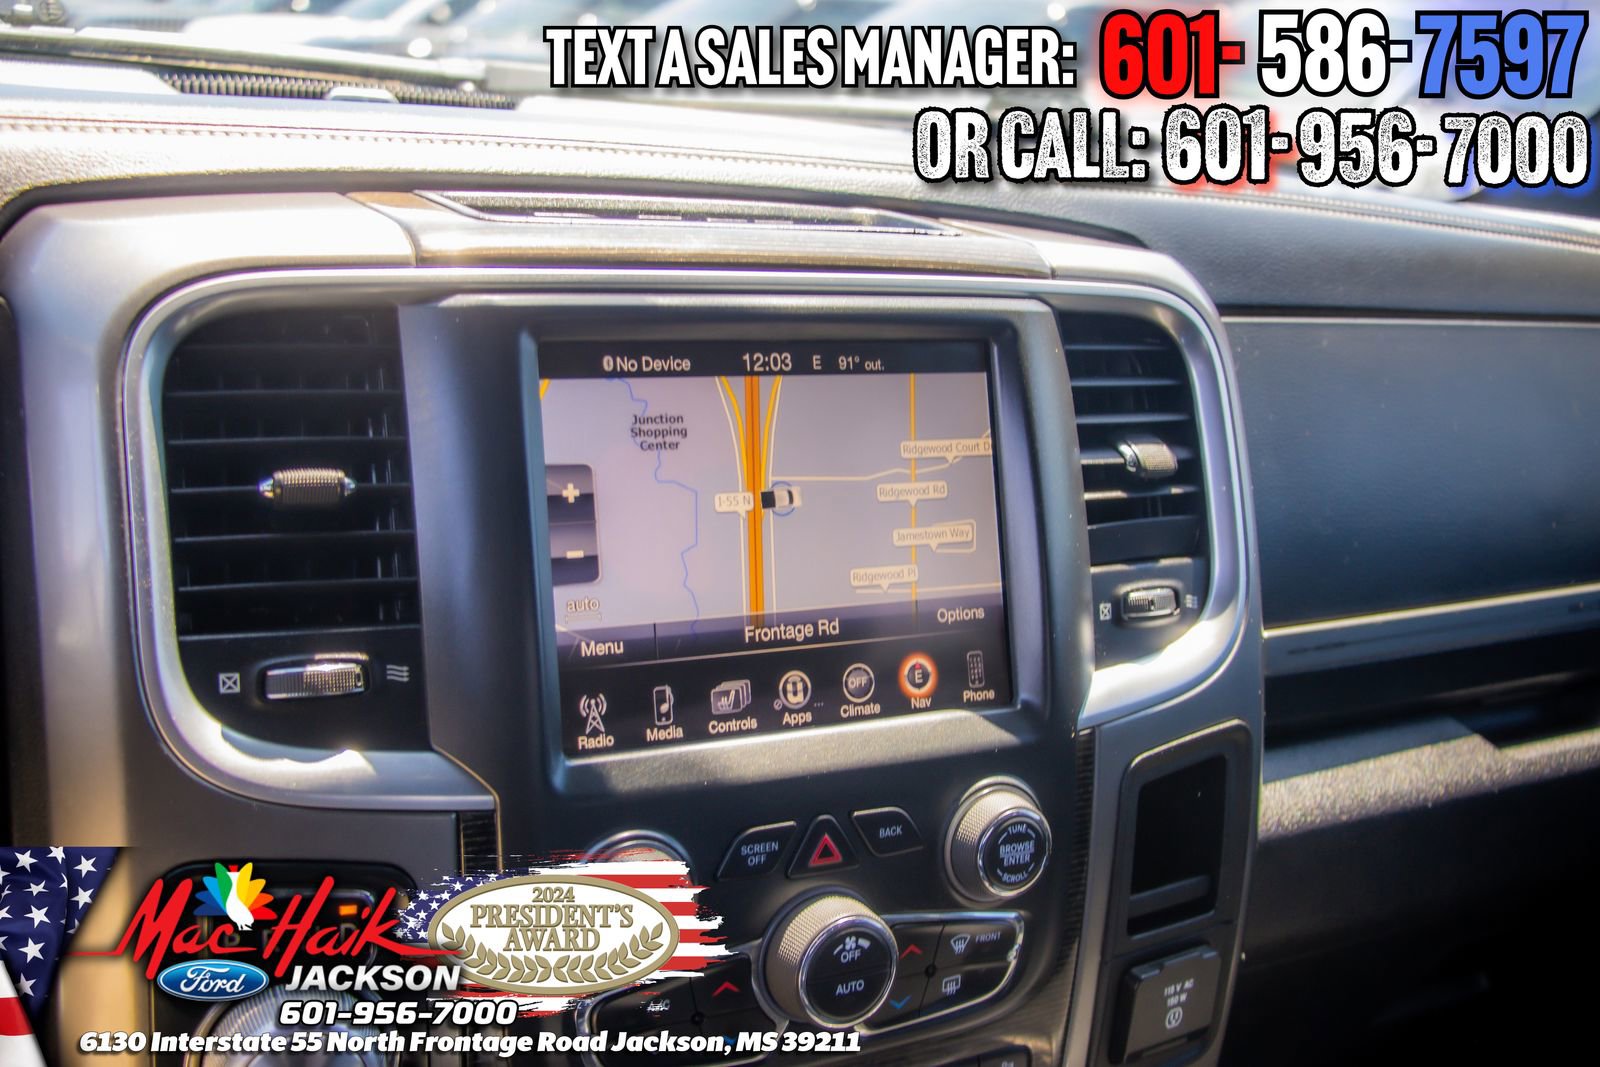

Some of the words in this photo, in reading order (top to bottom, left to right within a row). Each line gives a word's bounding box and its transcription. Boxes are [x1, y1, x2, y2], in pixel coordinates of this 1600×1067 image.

[616, 356, 638, 372] No
[641, 355, 691, 372] Device
[742, 352, 792, 372] 12:03
[812, 355, 822, 370] E
[864, 359, 885, 371] out.
[632, 413, 684, 425] Junction
[630, 427, 688, 440] Shopping
[640, 440, 680, 452] Center
[902, 442, 953, 456] Ridgewood
[955, 441, 980, 452] Court
[878, 485, 930, 499] Ridgewood
[932, 485, 946, 495] Rd
[896, 529, 948, 542] Jamestown
[950, 527, 970, 539] Way
[852, 569, 905, 584] Ridgewood
[566, 596, 600, 613] auto
[937, 606, 985, 624] Options
[744, 621, 814, 644] Frontage
[818, 617, 840, 637] Rd
[581, 640, 625, 657] Menu
[848, 676, 868, 689] OFF
[914, 669, 923, 684] E
[911, 696, 932, 710] Nav
[963, 689, 995, 703] Phone
[840, 702, 881, 718] Climate
[708, 716, 758, 735] Controls
[782, 710, 812, 726] Apps
[646, 724, 684, 742] Media
[578, 733, 615, 750] Radio
[879, 824, 903, 839] BACK
[1008, 823, 1027, 835] TUNE
[741, 840, 779, 856] SCREEN
[1000, 839, 1035, 856] BROWSE
[748, 854, 767, 867] OFF
[1003, 853, 1031, 867] ENTER
[1002, 870, 1029, 883] SCROLL
[975, 931, 1001, 944] FRONT
[840, 949, 861, 964] OFF
[836, 979, 865, 996] AUTO
